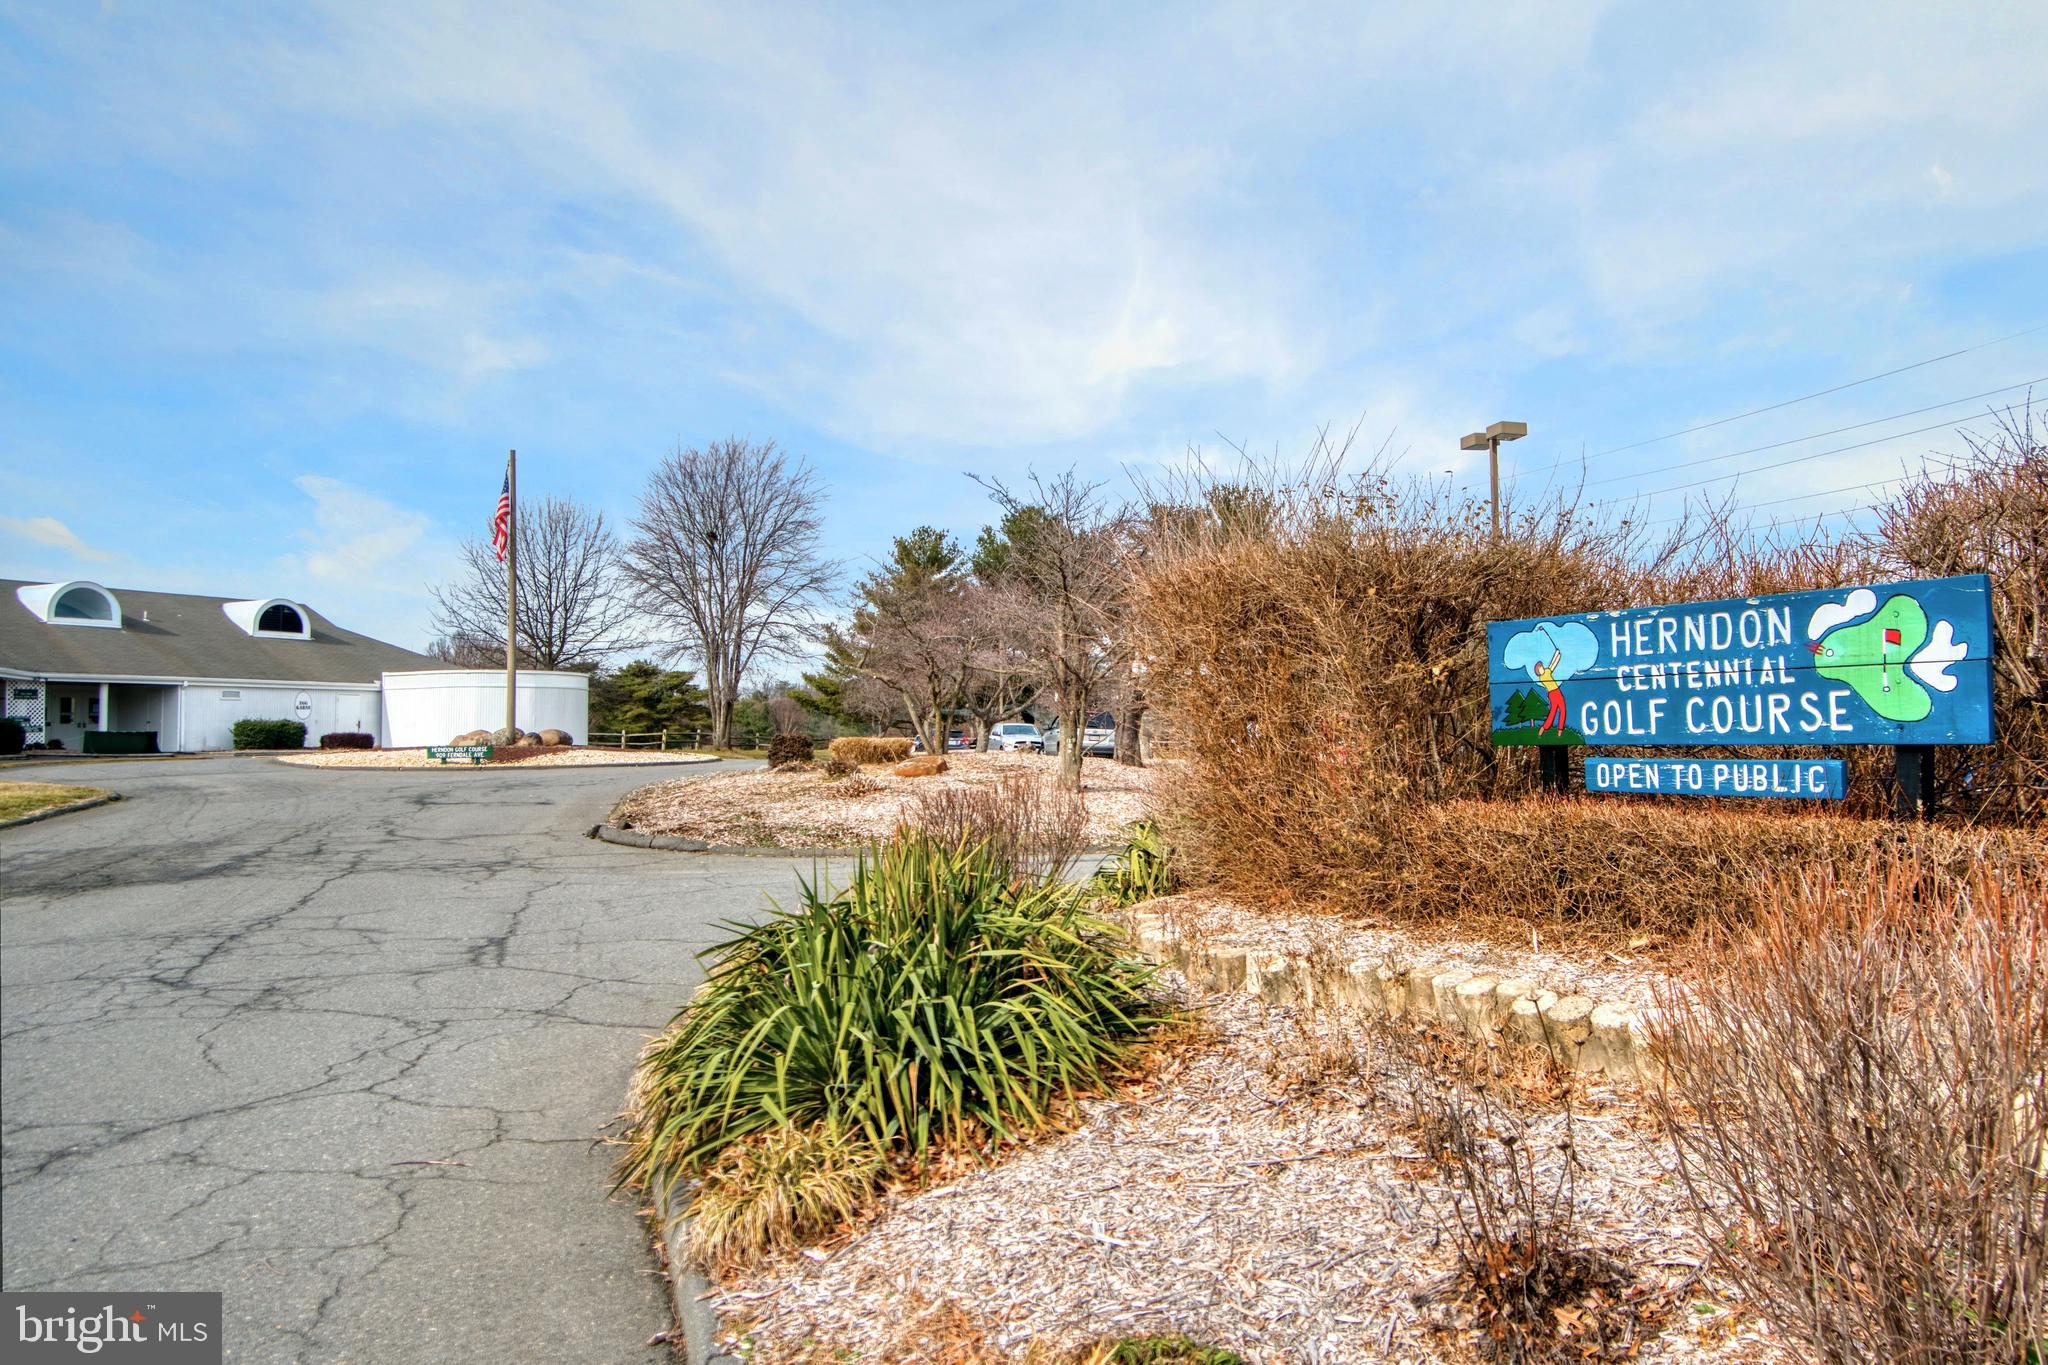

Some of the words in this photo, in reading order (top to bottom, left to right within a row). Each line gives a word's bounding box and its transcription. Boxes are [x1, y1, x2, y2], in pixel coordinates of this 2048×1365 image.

[1611, 606, 1792, 658] HERNDON
[1617, 656, 1796, 692] CENTENNIAL
[1581, 697, 1668, 736] GOLF
[1686, 690, 1854, 734] COURSE
[1597, 762, 1660, 790] OPEN
[1674, 762, 1704, 791] TO
[1714, 764, 1826, 794] PUBLIC
